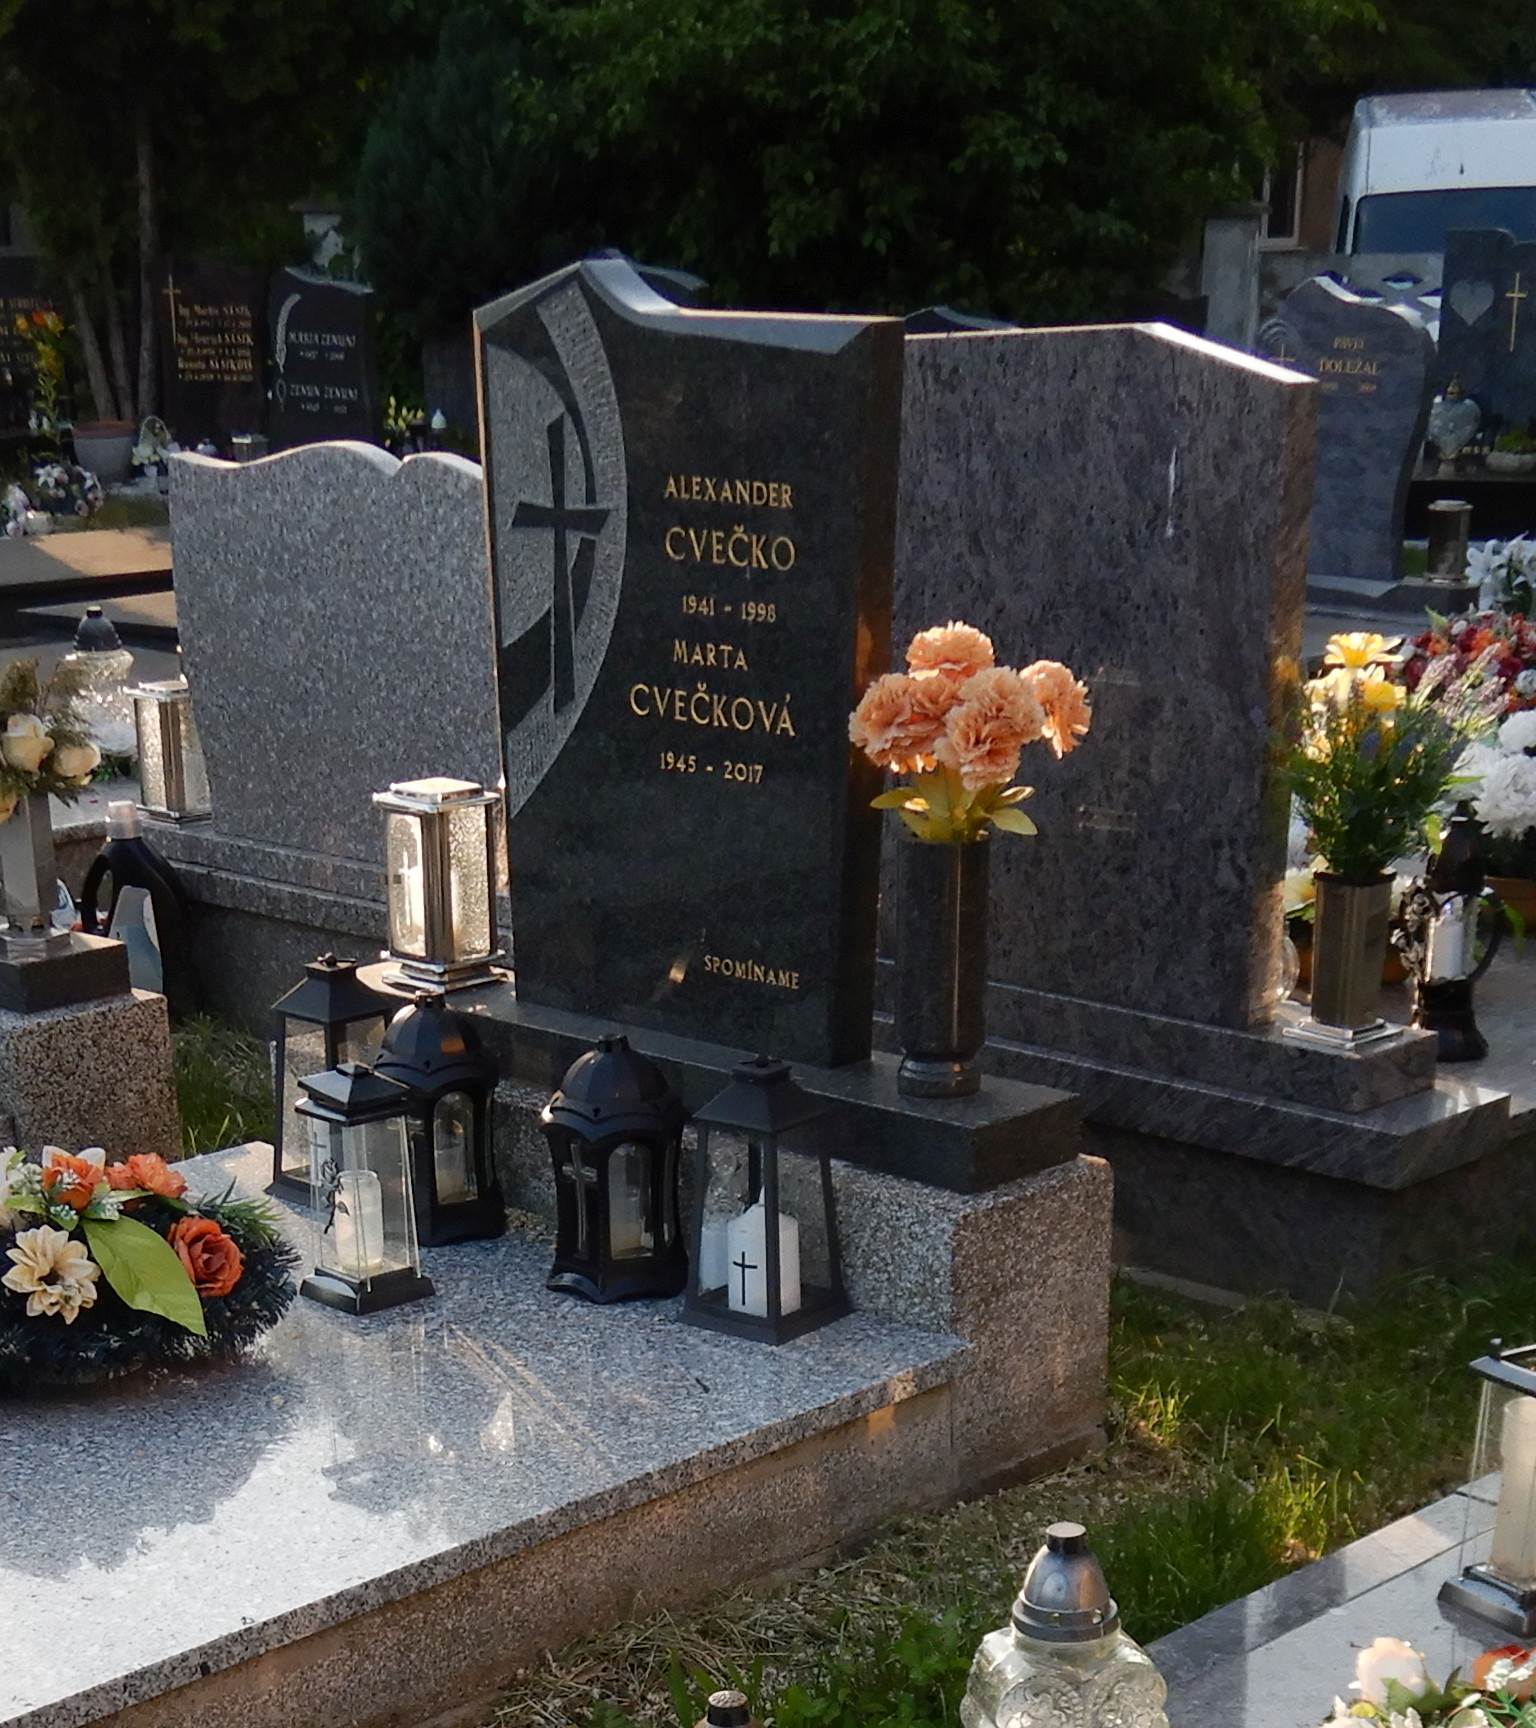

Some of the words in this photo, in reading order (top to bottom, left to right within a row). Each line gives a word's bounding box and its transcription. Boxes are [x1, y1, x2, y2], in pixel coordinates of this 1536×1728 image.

[664, 473, 794, 509] ALEXANDER
[664, 524, 797, 571] CVEČKO
[682, 595, 716, 617] 1941
[741, 601, 777, 624] 1998
[673, 638, 749, 672] MARTA
[629, 681, 796, 737] CVEČKOVÁ
[658, 751, 697, 774] 1945
[723, 761, 764, 784] 2017
[704, 954, 800, 990] SPOMÍNAME
